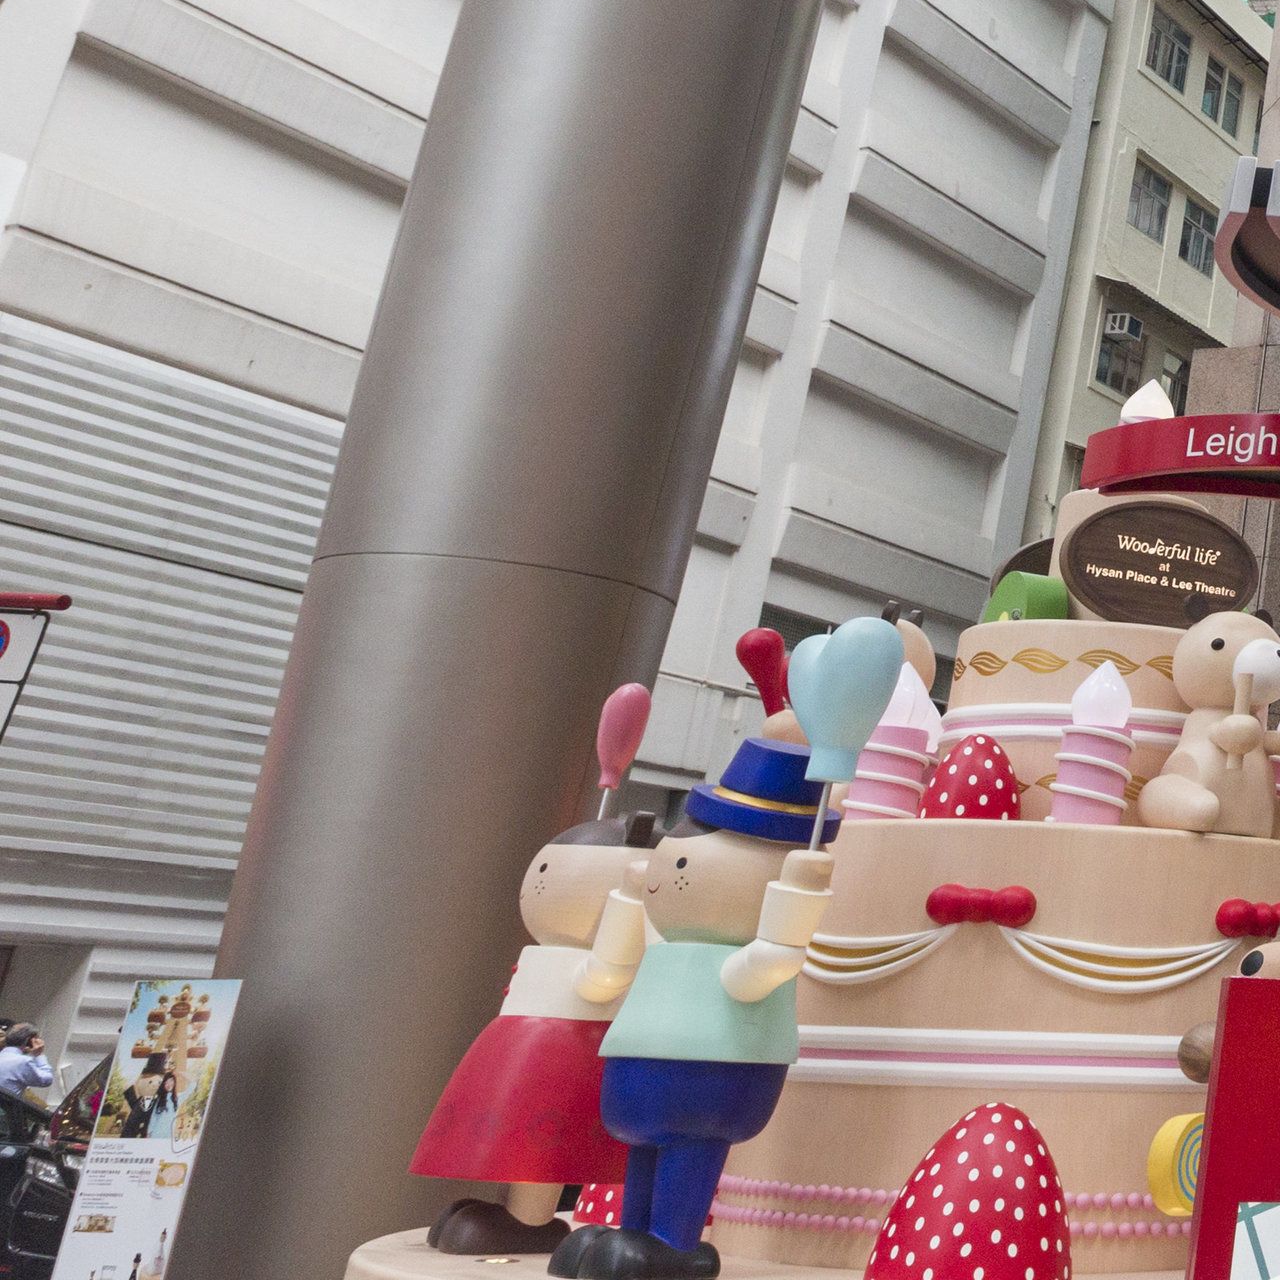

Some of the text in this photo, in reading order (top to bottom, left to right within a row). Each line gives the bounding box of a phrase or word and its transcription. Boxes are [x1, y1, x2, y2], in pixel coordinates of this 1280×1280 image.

[1159, 562, 1170, 573] at
[1086, 563, 1236, 598] Hysan Place & Lee Theatre
